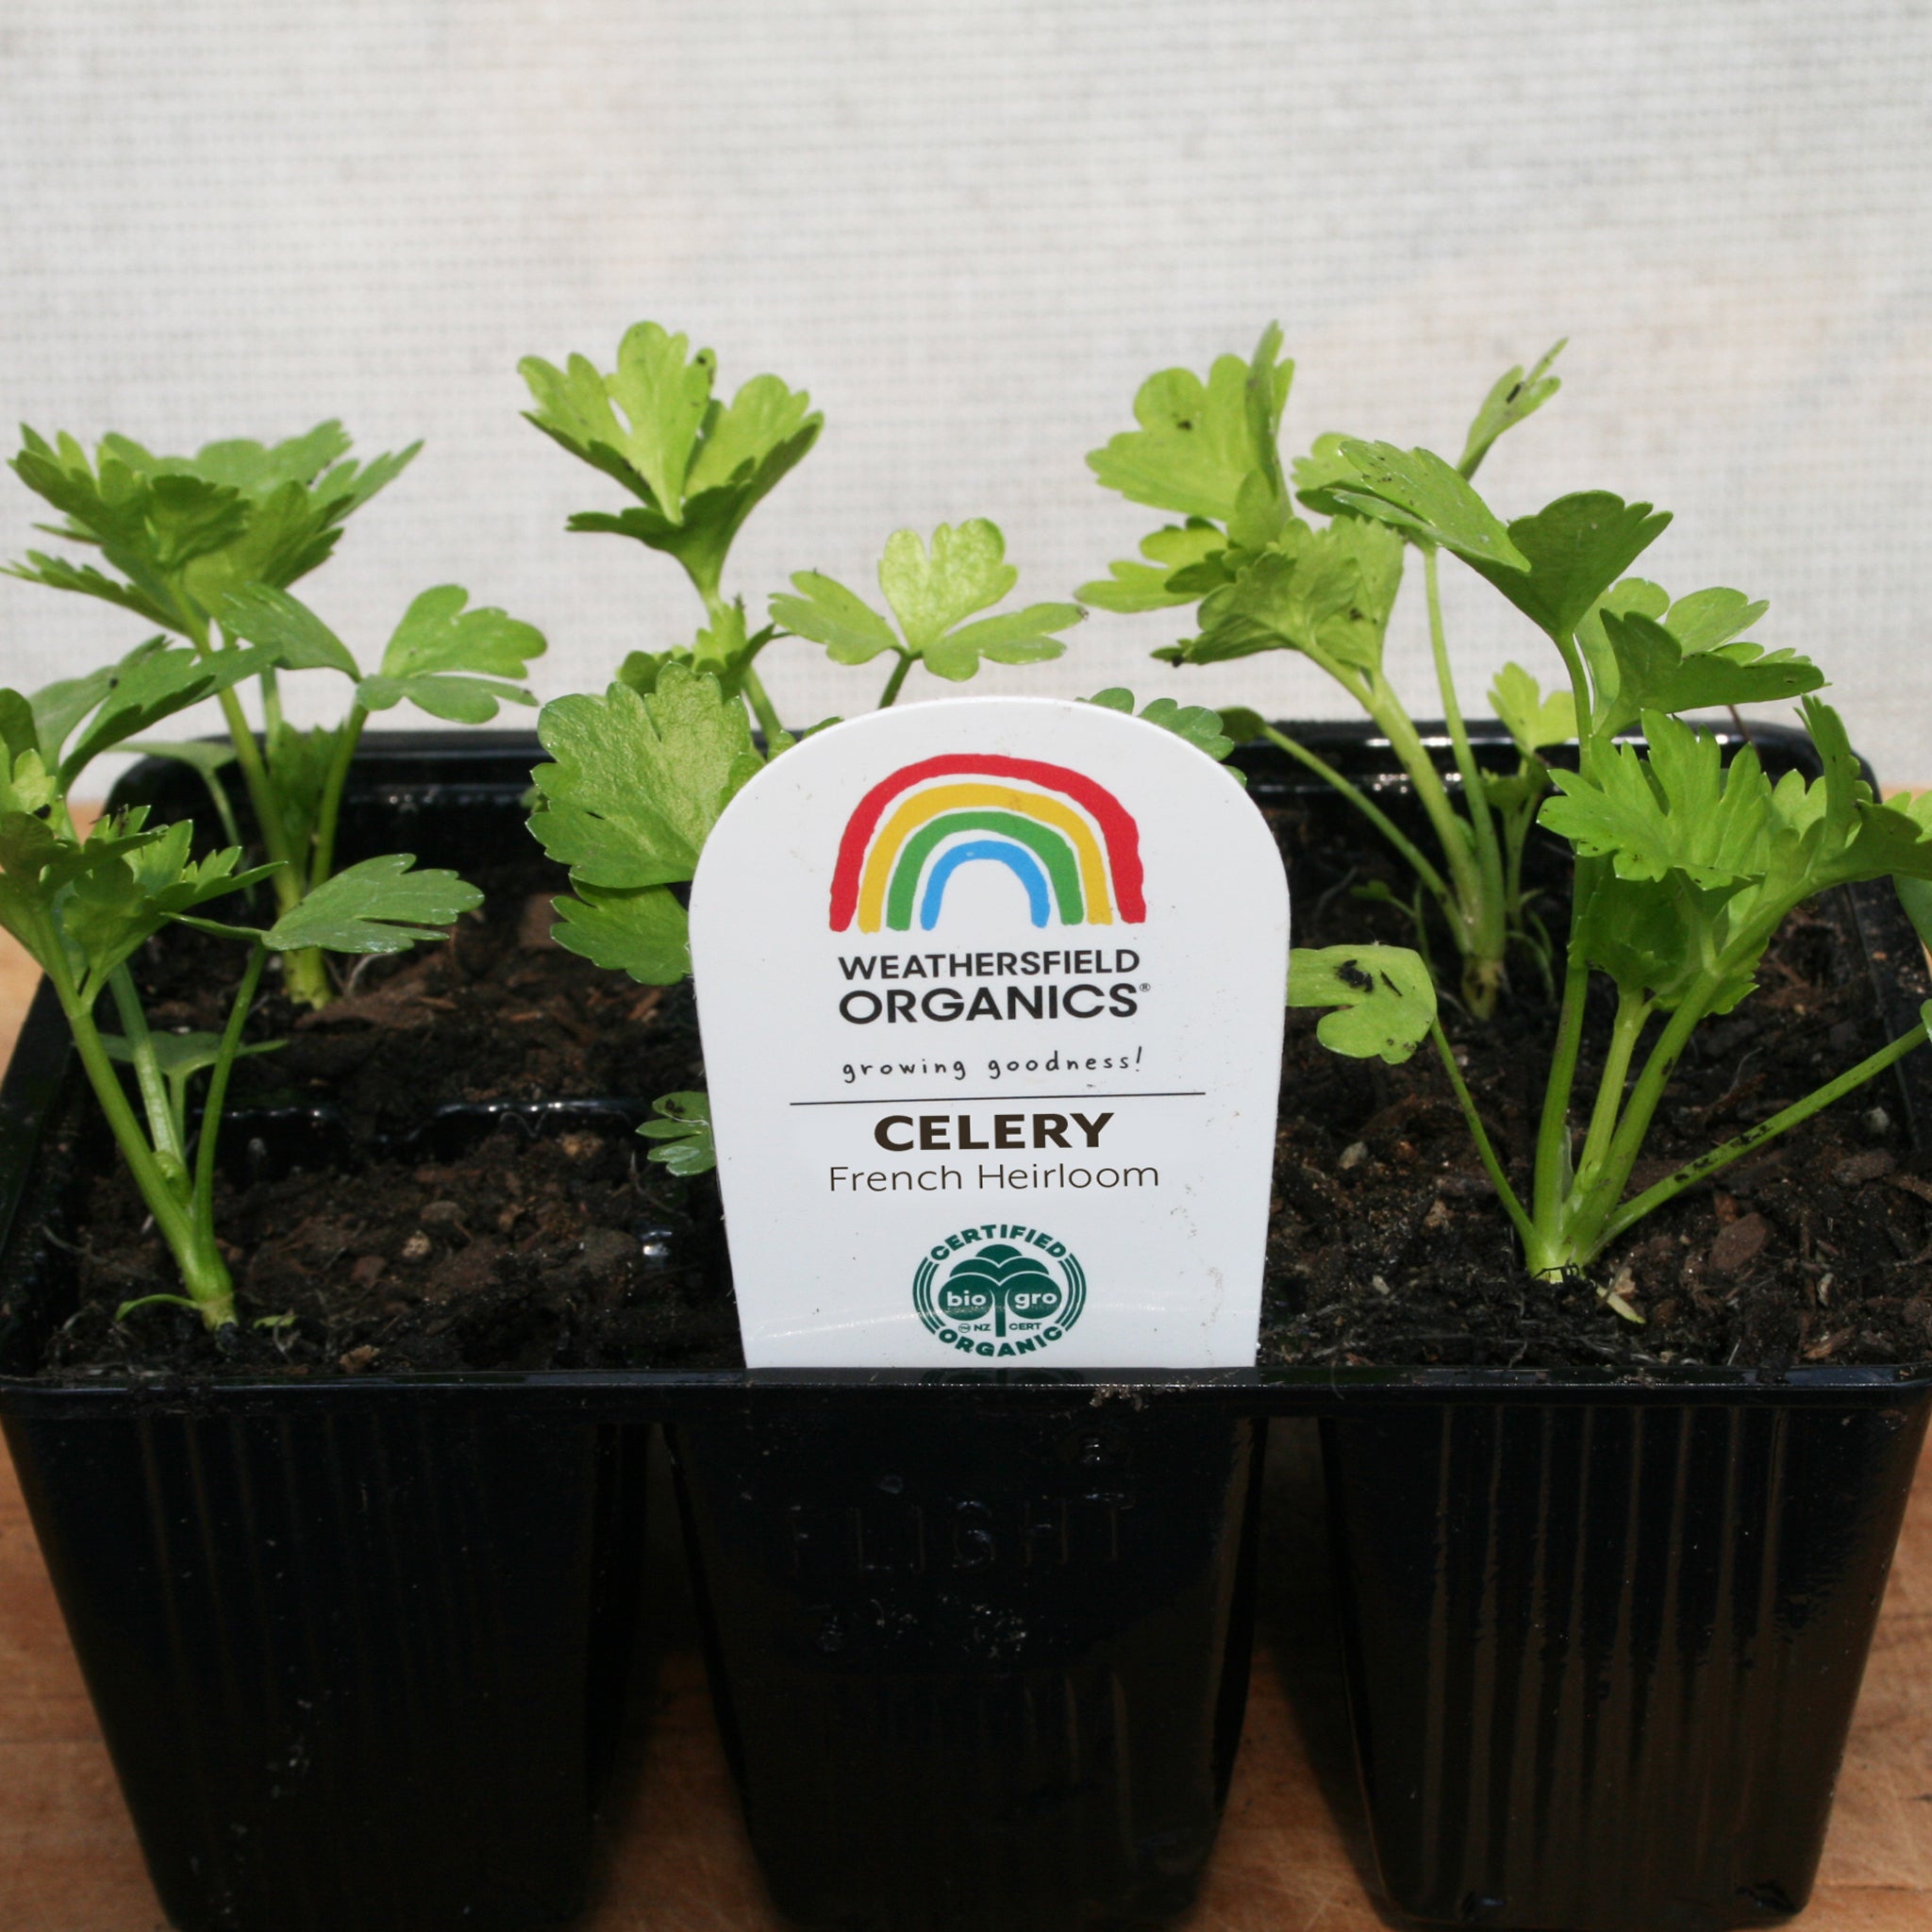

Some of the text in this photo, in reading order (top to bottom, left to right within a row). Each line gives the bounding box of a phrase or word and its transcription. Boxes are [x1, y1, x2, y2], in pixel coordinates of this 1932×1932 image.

[838, 949, 1141, 980] WEATHERSFIELD
[842, 1046, 1143, 1084] growing goodness!
[874, 1112, 1114, 1152] CELERY
[829, 1162, 1159, 1192] French Heirloom
[930, 1224, 1067, 1261] CERTIFIED
[946, 1290, 1058, 1309] bio gro
[939, 1325, 1062, 1357] ORGANIC
[974, 1323, 991, 1332] NZ
[1008, 1322, 1042, 1331] CERT
